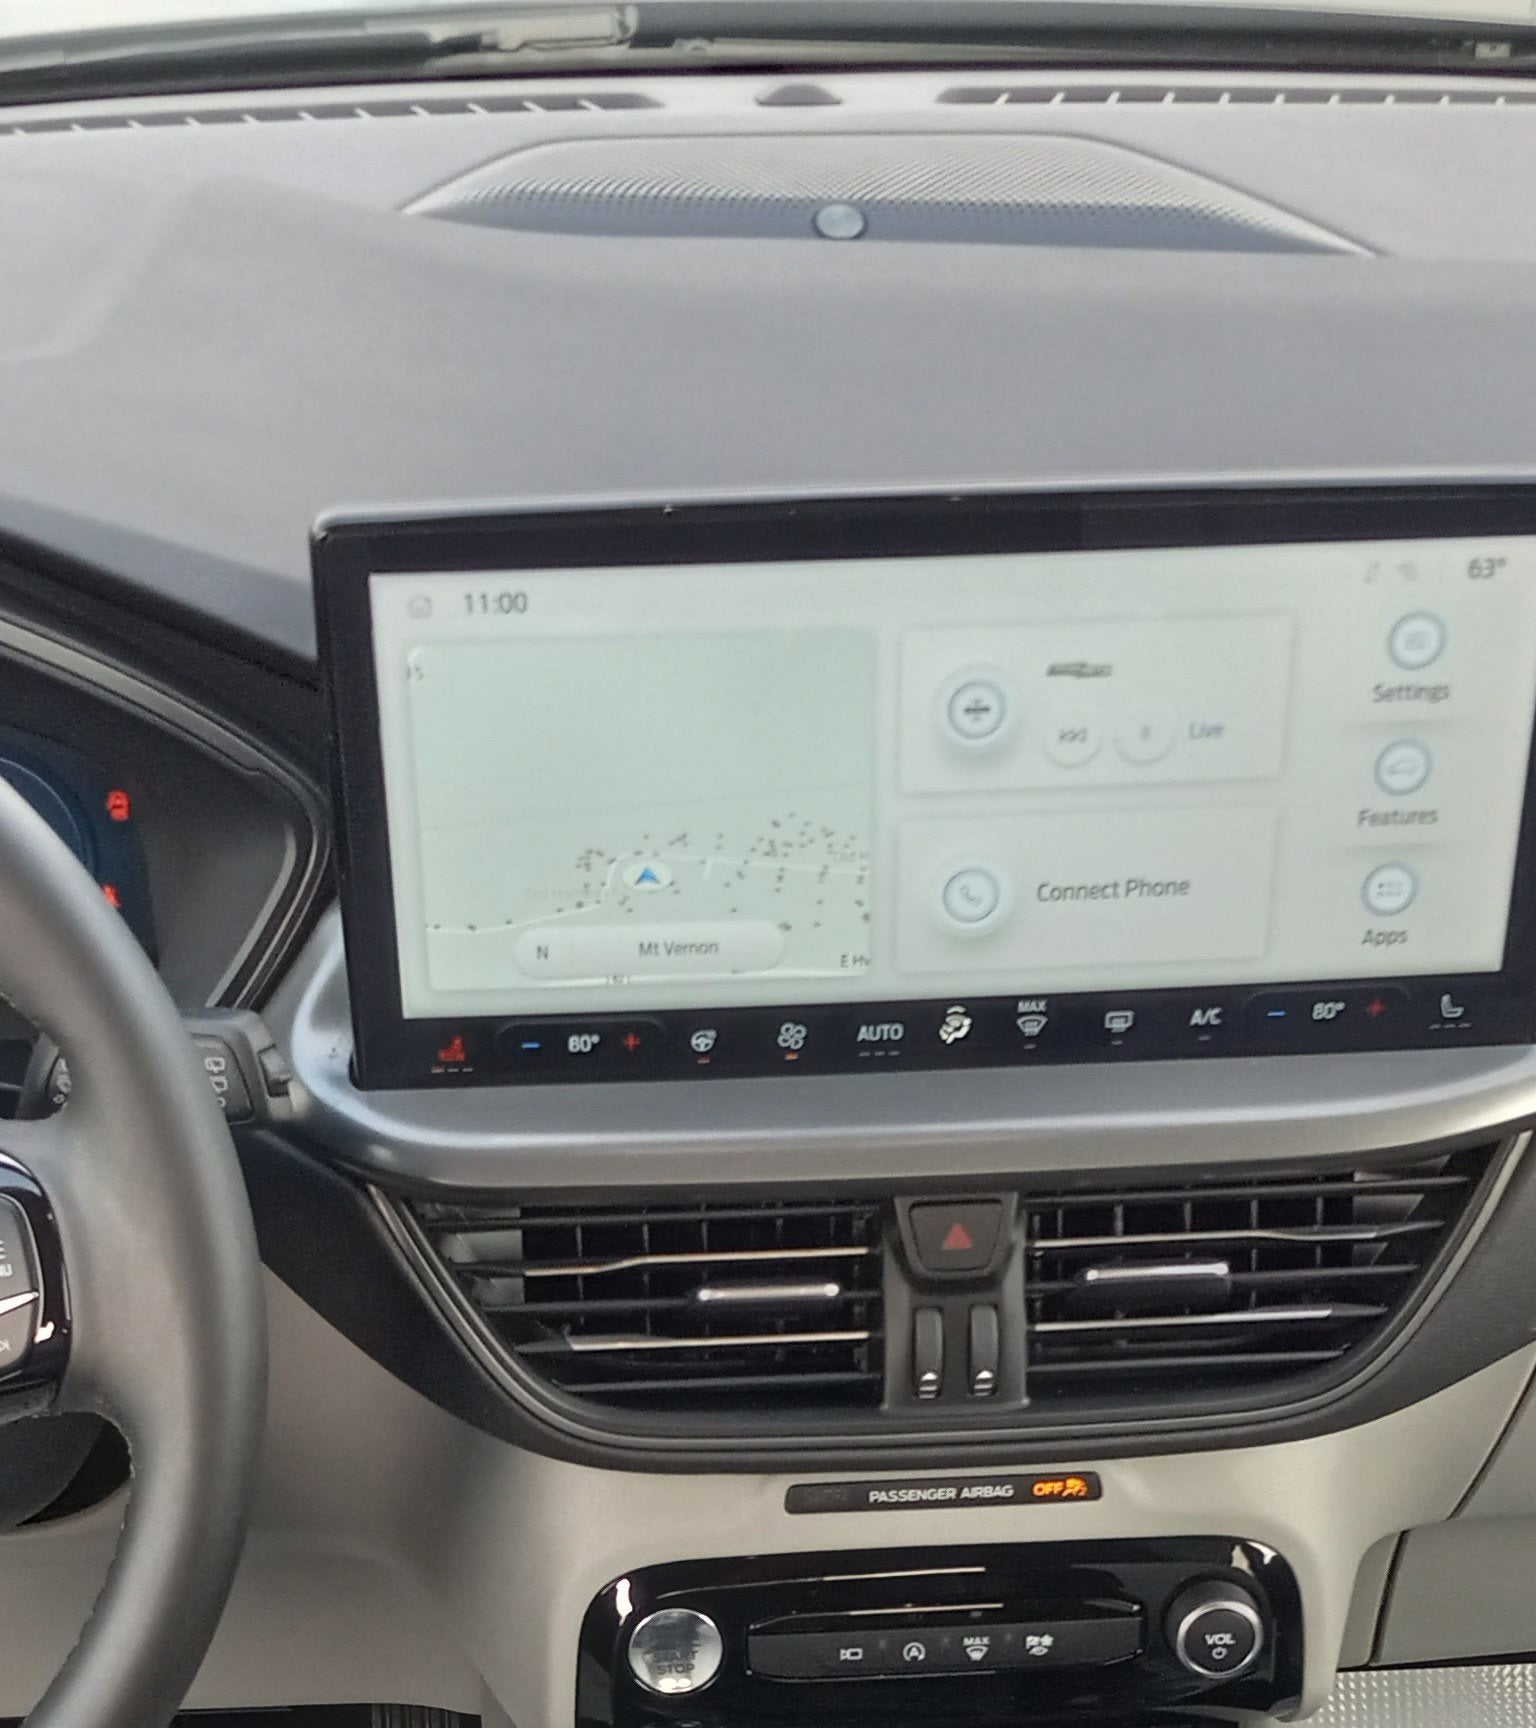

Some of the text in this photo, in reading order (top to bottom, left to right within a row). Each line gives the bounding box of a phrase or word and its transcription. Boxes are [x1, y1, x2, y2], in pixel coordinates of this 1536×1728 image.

[465, 591, 529, 614] 11:00
[1373, 683, 1451, 704] Settings
[1357, 807, 1439, 829] Features
[1036, 877, 1192, 903] Connect Phone
[1362, 928, 1409, 947] Apps
[638, 941, 720, 956] Mt Vernon
[1017, 1000, 1048, 1013] MAX
[1189, 1007, 1223, 1026] A/C
[857, 1023, 905, 1043] AUTO
[868, 1481, 1064, 1504] PASSENGER AIRBAG OFF
[963, 1636, 991, 1646] MAX
[1205, 1633, 1237, 1645] VOL
[657, 1663, 695, 1675] STOP
